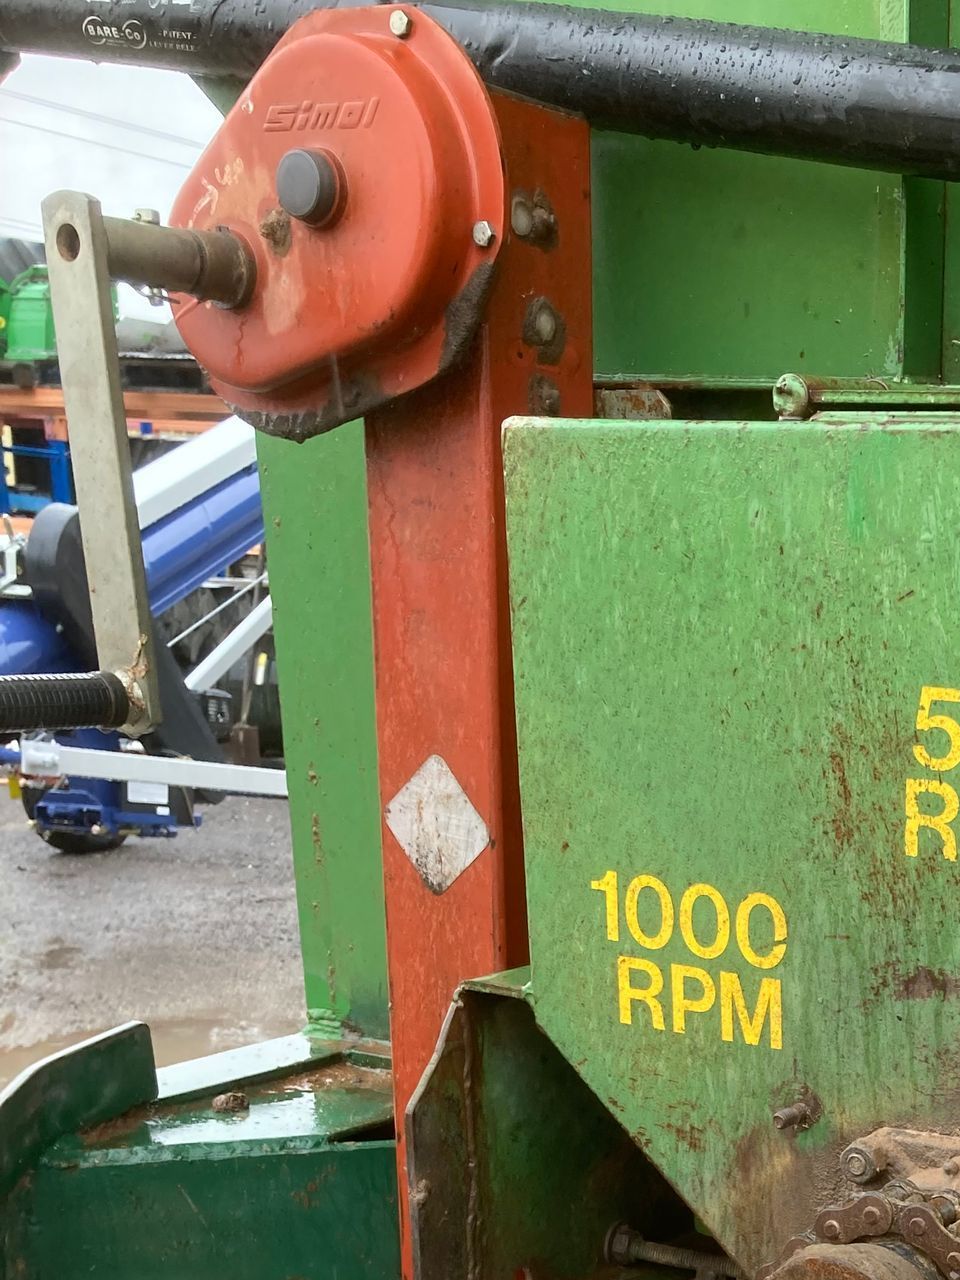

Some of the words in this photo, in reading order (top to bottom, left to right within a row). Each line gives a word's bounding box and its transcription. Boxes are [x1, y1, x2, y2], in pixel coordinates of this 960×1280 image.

[263, 97, 380, 132] Simol
[591, 870, 787, 969] 1000
[617, 955, 782, 1050] RPM
